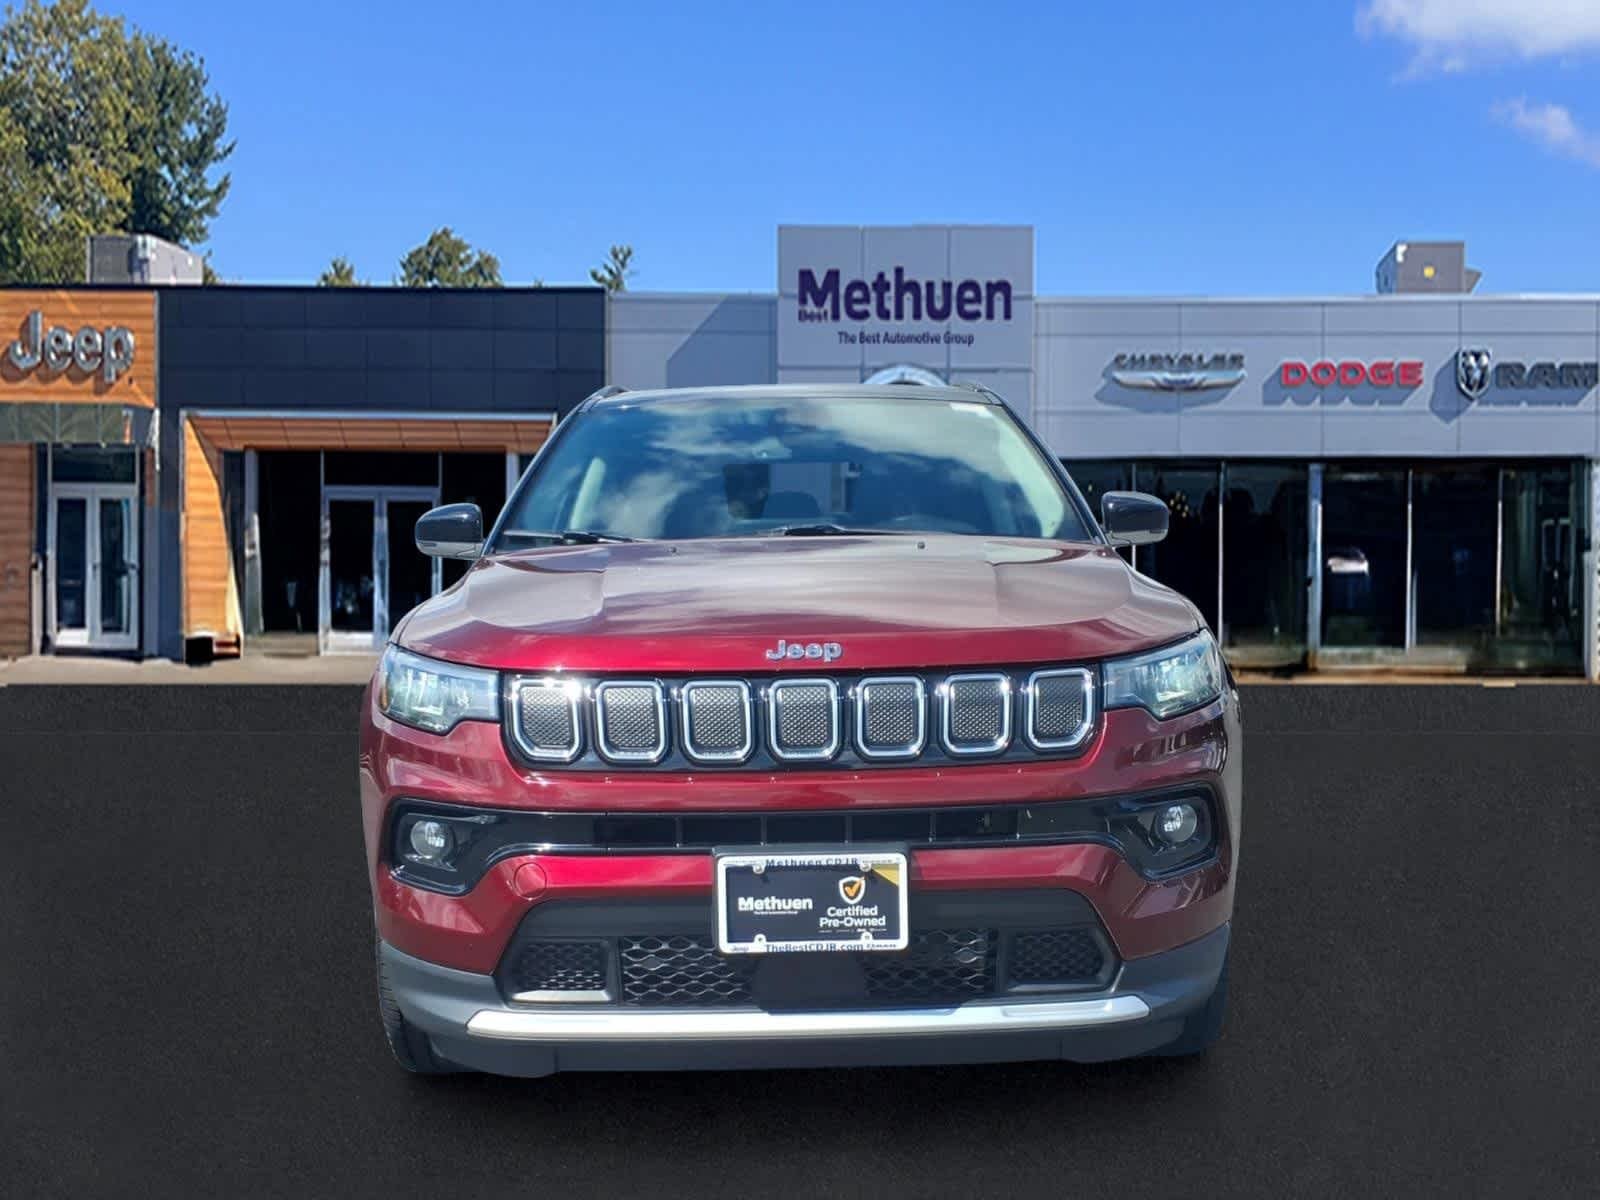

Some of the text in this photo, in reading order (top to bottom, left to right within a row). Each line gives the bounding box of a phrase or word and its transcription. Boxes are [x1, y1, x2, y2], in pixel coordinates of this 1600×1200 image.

[798, 266, 1012, 321] Methuen
[798, 308, 828, 322] Best
[8, 310, 135, 384] Jeep
[838, 331, 974, 347] The Best Automotive Group
[1113, 353, 1244, 370] CHRYSLER
[1281, 361, 1423, 387] DODGE
[1496, 361, 1599, 390] RAM
[766, 639, 842, 662] Jeep
[765, 858, 822, 868] Methuen
[738, 896, 813, 911] Methuen
[826, 905, 878, 917] Certified
[819, 915, 886, 928] Pre-Owned
